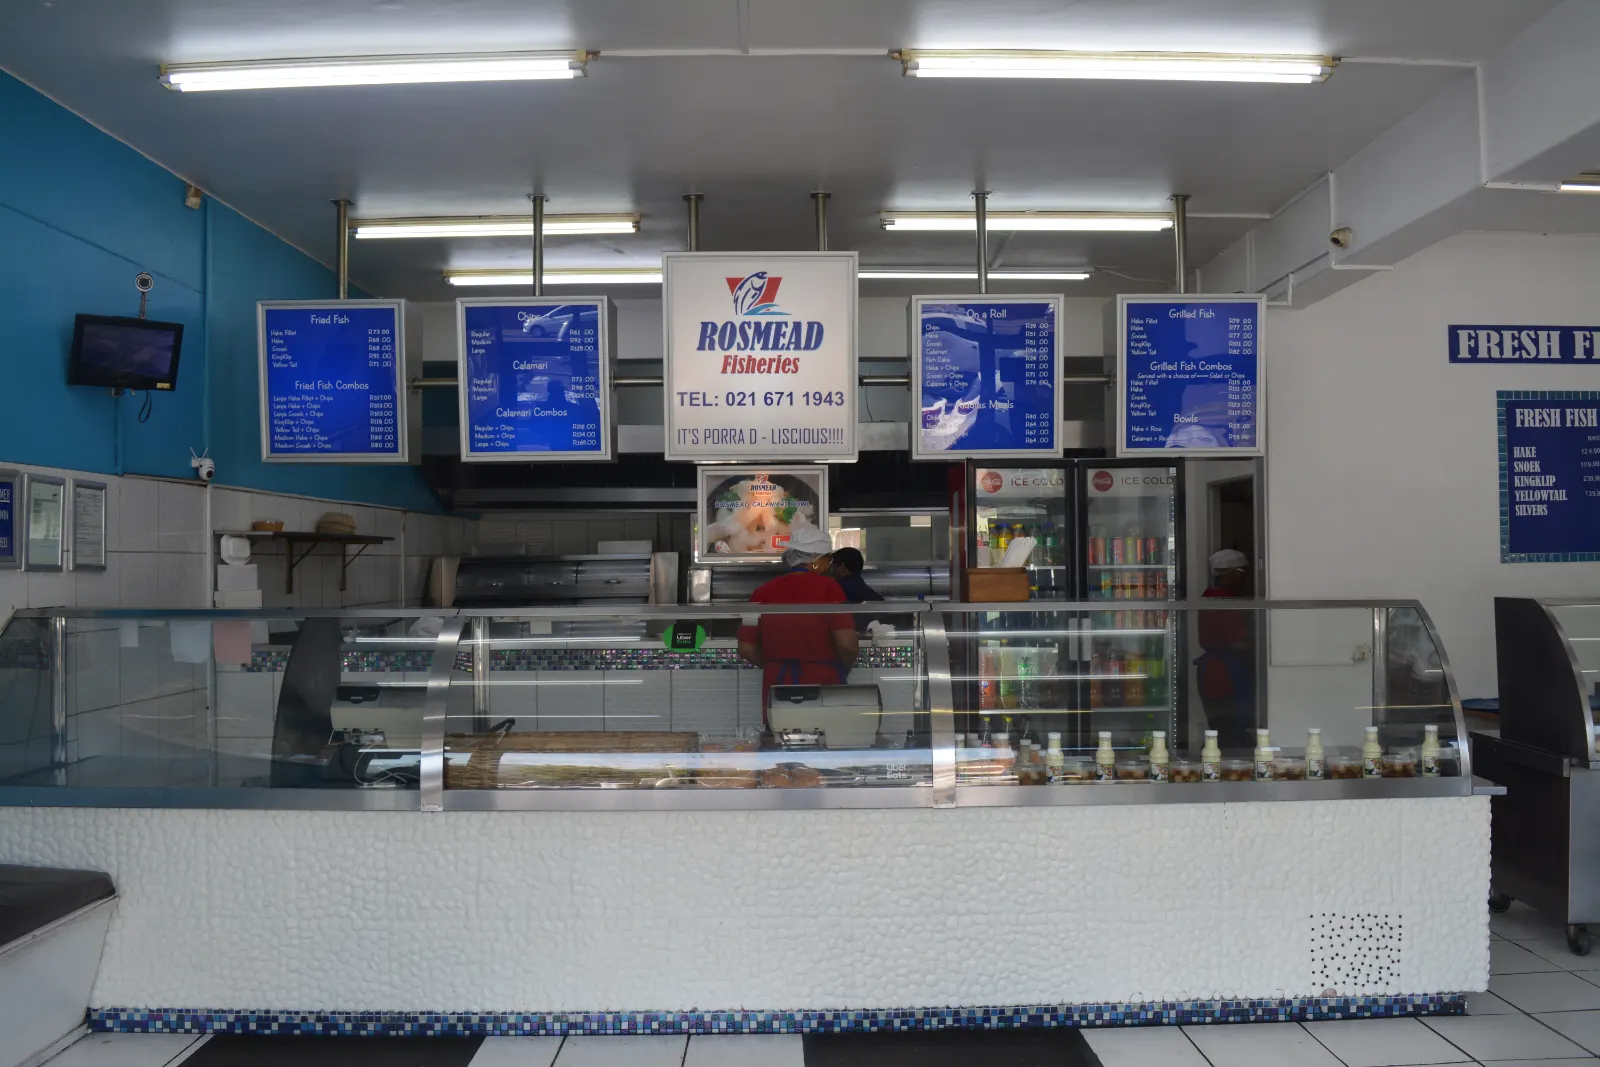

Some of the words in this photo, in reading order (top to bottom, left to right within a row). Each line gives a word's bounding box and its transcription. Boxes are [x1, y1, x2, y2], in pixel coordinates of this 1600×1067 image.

[311, 315, 331, 324] Fried
[333, 314, 349, 324] Fish
[967, 309, 979, 319] On
[990, 309, 1007, 318] Roll
[1169, 309, 1196, 319] Grilled
[1199, 309, 1215, 318] Fish
[697, 320, 824, 351] ROSMEAD
[1457, 330, 1561, 359] FRESH
[513, 361, 548, 370] Calamari
[720, 355, 800, 374] Fisheries
[1150, 362, 1177, 371] Grilled
[1180, 361, 1196, 371] Fish
[1199, 361, 1232, 371] Combos
[295, 381, 315, 390] Fried
[318, 381, 333, 389] Fish
[336, 380, 369, 390] Combos
[677, 392, 719, 407] TEL:
[725, 392, 756, 407] 021
[763, 392, 794, 406] 671
[803, 392, 845, 406] 1943
[989, 400, 1014, 409] Meals
[496, 408, 531, 417] Calamari
[534, 408, 567, 417] Combos
[1174, 414, 1198, 423] Bowls
[1515, 409, 1561, 428] FRESH
[1566, 408, 1598, 427] FISH
[678, 428, 699, 445] IT'S
[704, 428, 745, 444] PORRA
[749, 429, 757, 444] D
[772, 428, 844, 444] LISCIOUS!!!!
[1514, 447, 1536, 458] HAKE
[1514, 461, 1541, 472] SNOEK
[1011, 478, 1029, 486] ICE
[1033, 477, 1064, 486] COLD
[1122, 476, 1139, 485] ICE
[1143, 476, 1174, 485] COLD
[1514, 476, 1556, 487] KINGKLIP
[1515, 490, 1568, 501] YELLOWTAIL
[715, 500, 749, 509] ROSMEAD
[1515, 504, 1548, 516] SILVERS
[886, 763, 907, 771] Uber
